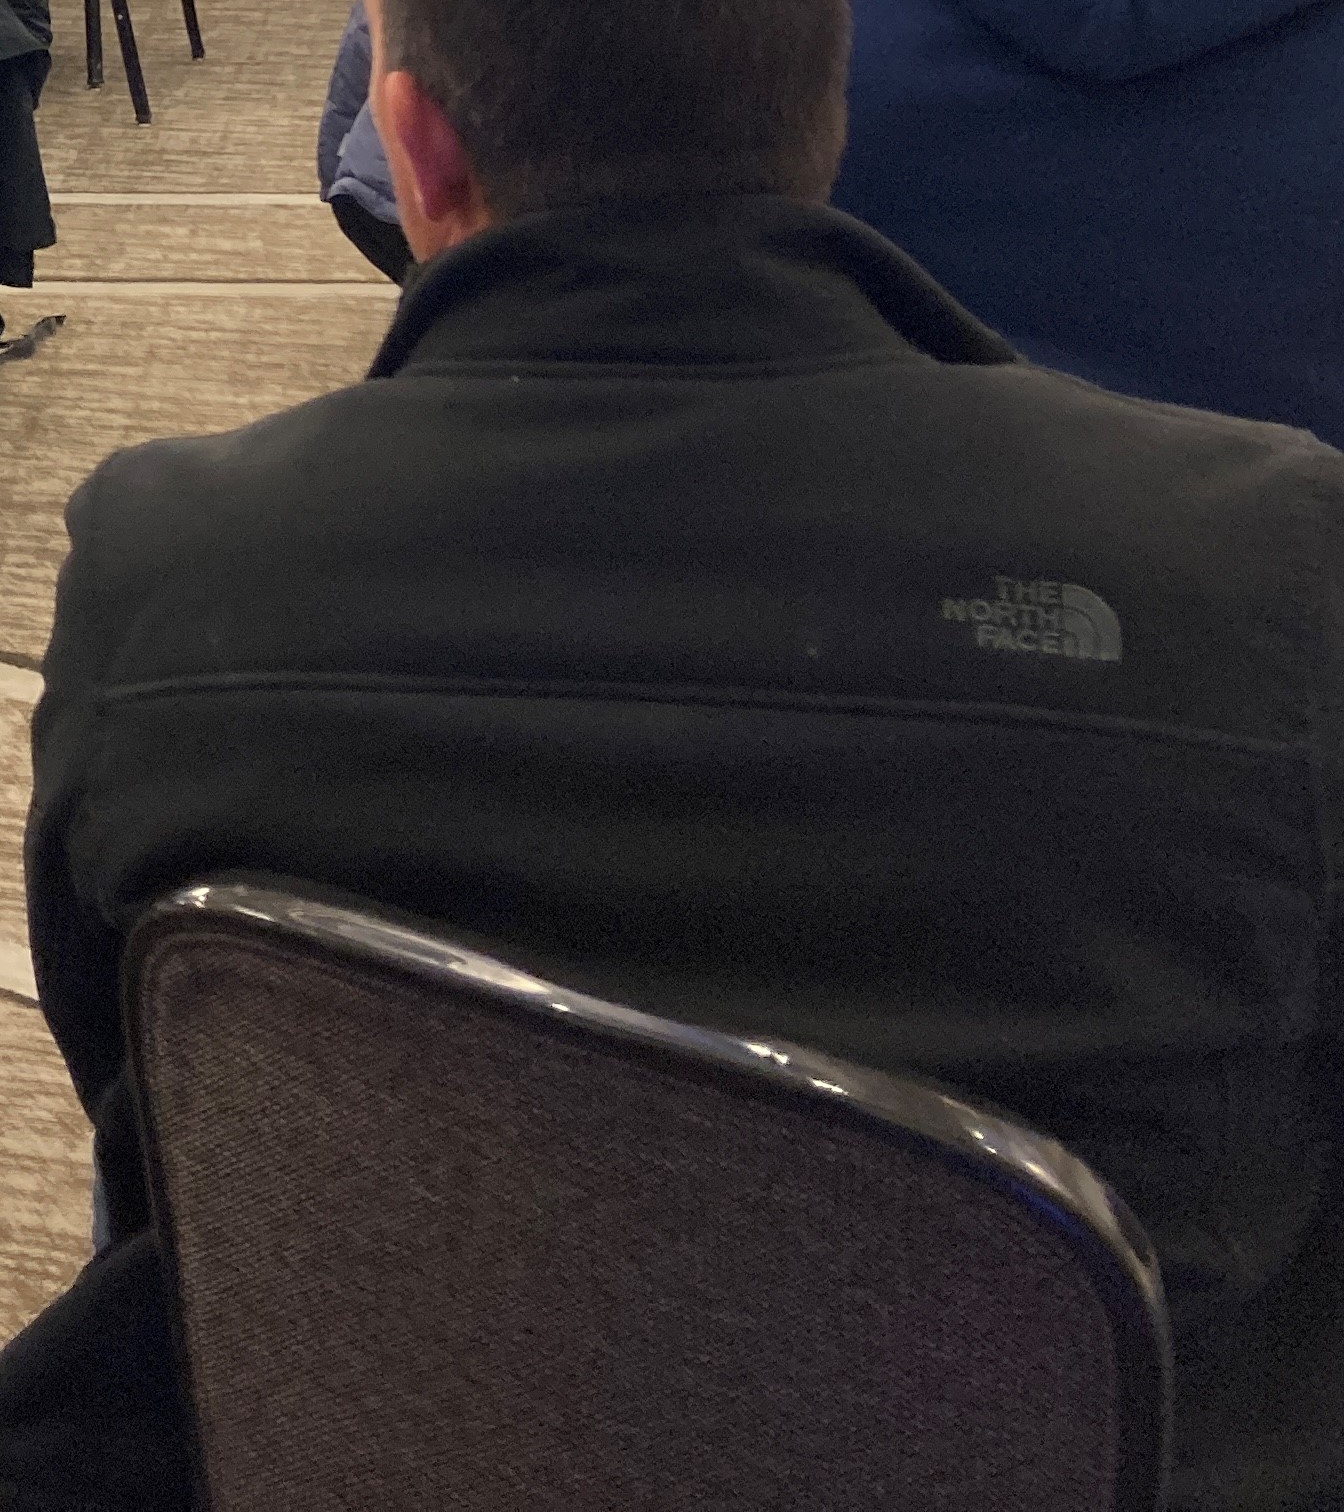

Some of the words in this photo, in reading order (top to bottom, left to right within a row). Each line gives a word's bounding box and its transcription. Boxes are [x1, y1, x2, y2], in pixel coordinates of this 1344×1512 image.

[994, 575, 1058, 604] THE
[939, 598, 1062, 630] NORTH
[978, 624, 1060, 654] FACE
